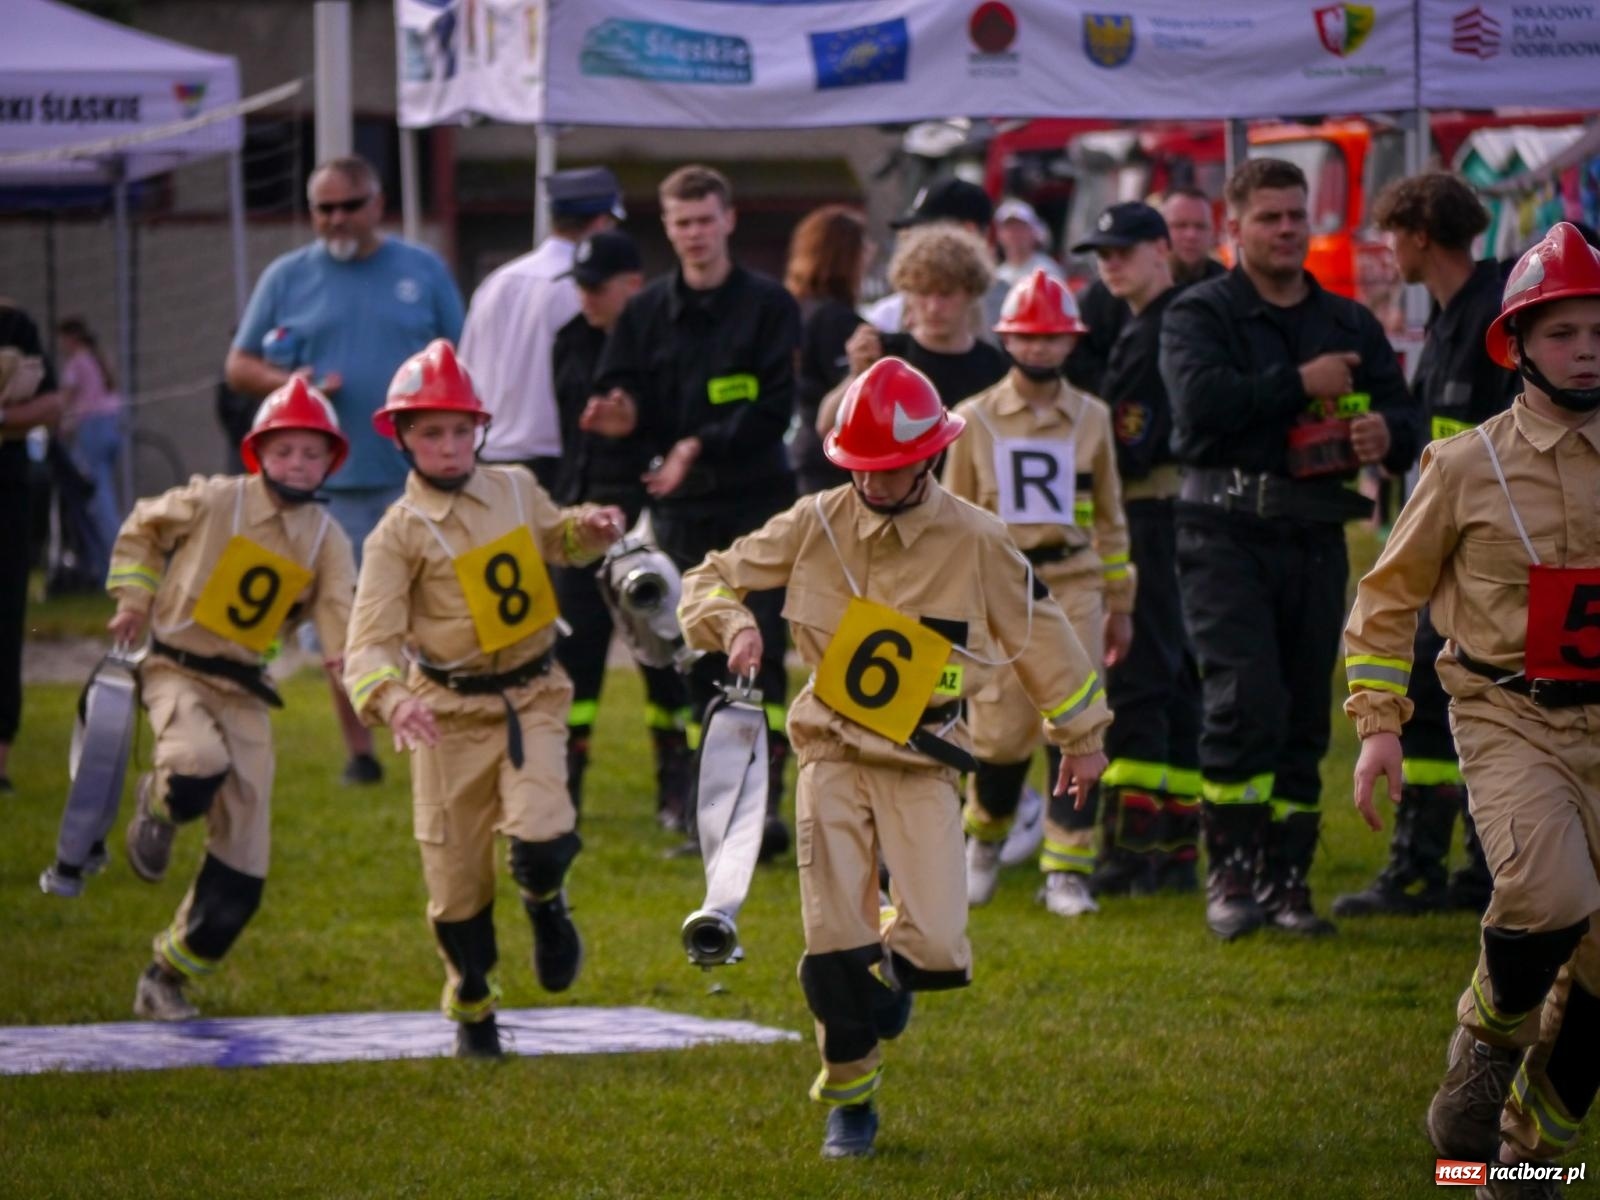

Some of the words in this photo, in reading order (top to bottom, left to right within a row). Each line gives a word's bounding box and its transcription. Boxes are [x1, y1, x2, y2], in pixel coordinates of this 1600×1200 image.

[1512, 24, 1556, 38] PLAN
[41, 90, 140, 126] ŚLĄSKIE
[1011, 451, 1063, 513] R
[227, 566, 280, 630] 9
[485, 551, 531, 627] 8
[1560, 584, 1600, 670] 5
[845, 629, 912, 709] 6
